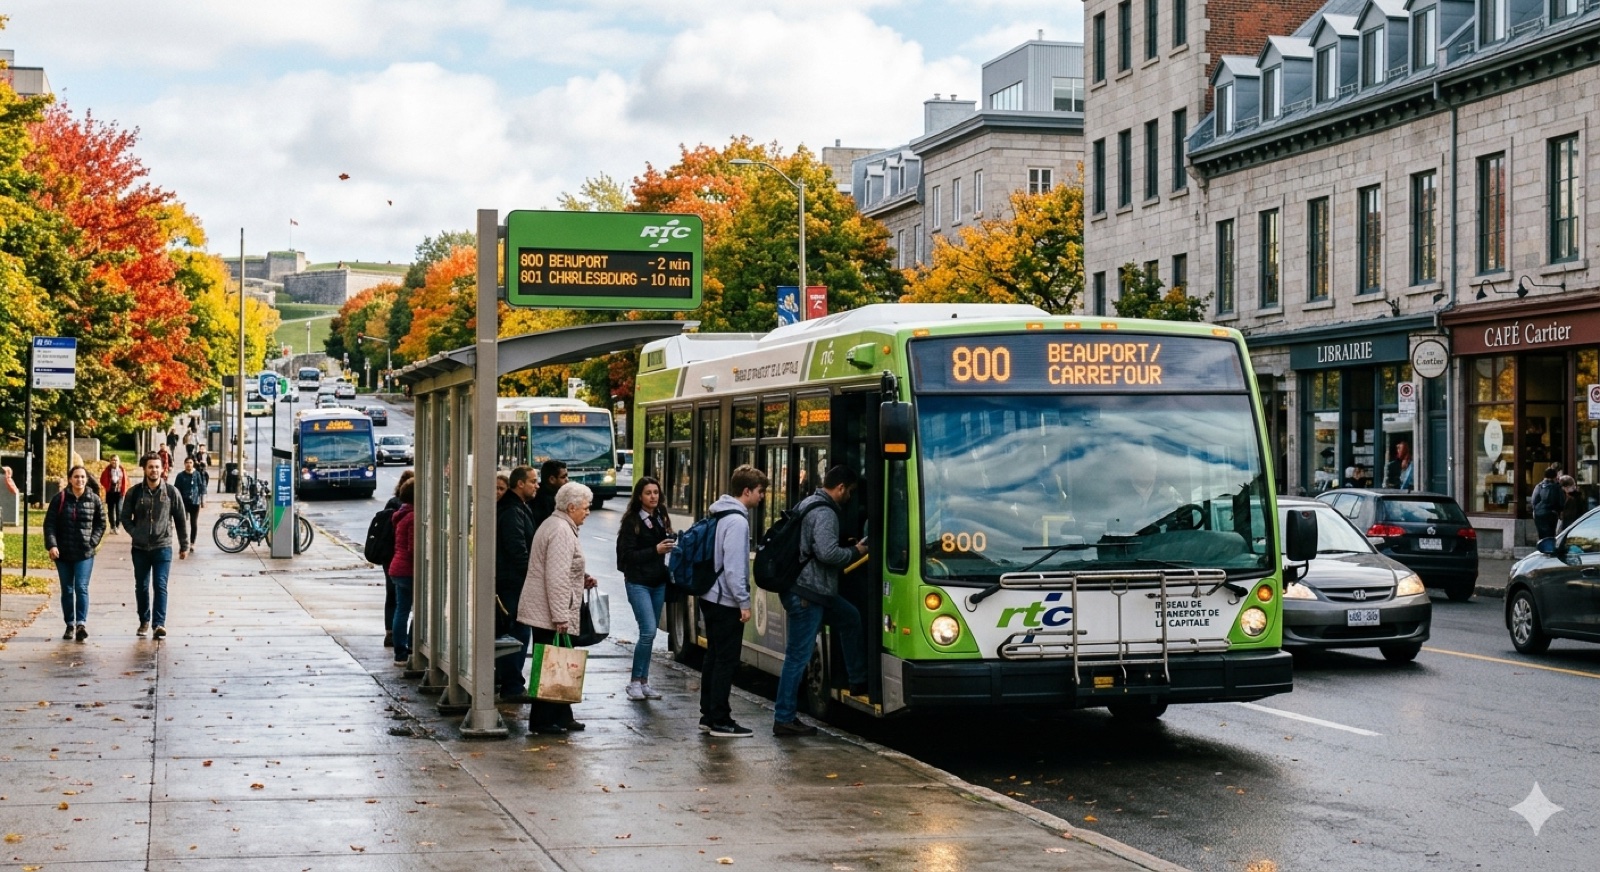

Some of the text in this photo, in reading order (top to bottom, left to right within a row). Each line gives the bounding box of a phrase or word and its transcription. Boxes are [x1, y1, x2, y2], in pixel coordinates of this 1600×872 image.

[640, 226, 692, 239] RTC
[1484, 321, 1572, 347] CAFÉ Cartier
[1048, 343, 1162, 363] BEAUPORT/
[1317, 341, 1373, 363] LIBRAIRIE
[952, 346, 1010, 382] 800
[1048, 365, 1162, 385] CARREFOUR
[941, 532, 987, 552] 800
[996, 601, 1074, 628] rtc
[1155, 601, 1188, 609] RSEAU
[1208, 609, 1220, 617] DE
[1169, 618, 1210, 627] CAPITALE
